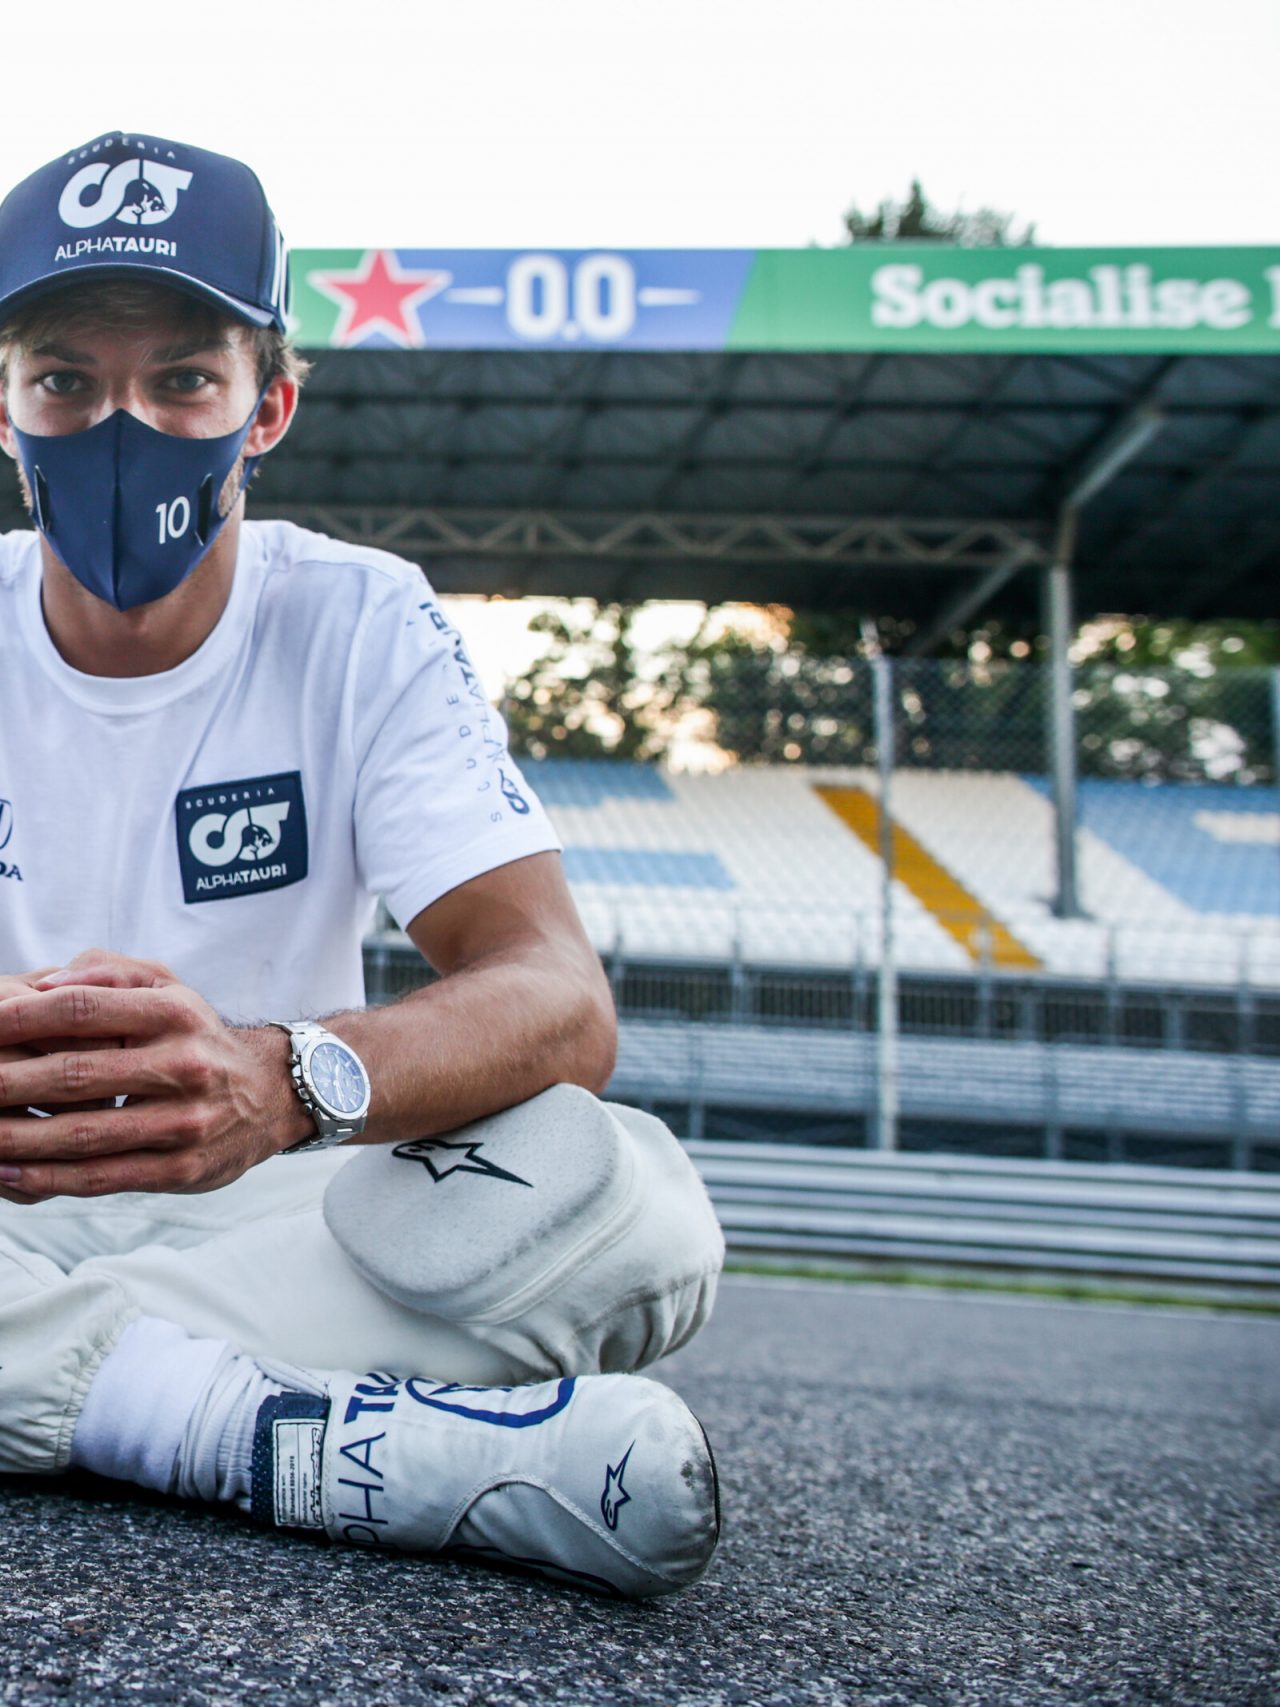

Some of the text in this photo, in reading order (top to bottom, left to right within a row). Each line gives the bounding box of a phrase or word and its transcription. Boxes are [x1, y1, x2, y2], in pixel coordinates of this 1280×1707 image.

[54, 236, 177, 262] ALPHATAURI
[506, 253, 636, 342] 0.0
[869, 263, 1255, 330] Socialise
[156, 496, 190, 545] 10
[185, 787, 275, 810] SCUDERIA
[195, 863, 288, 892] ALPHATAURI
